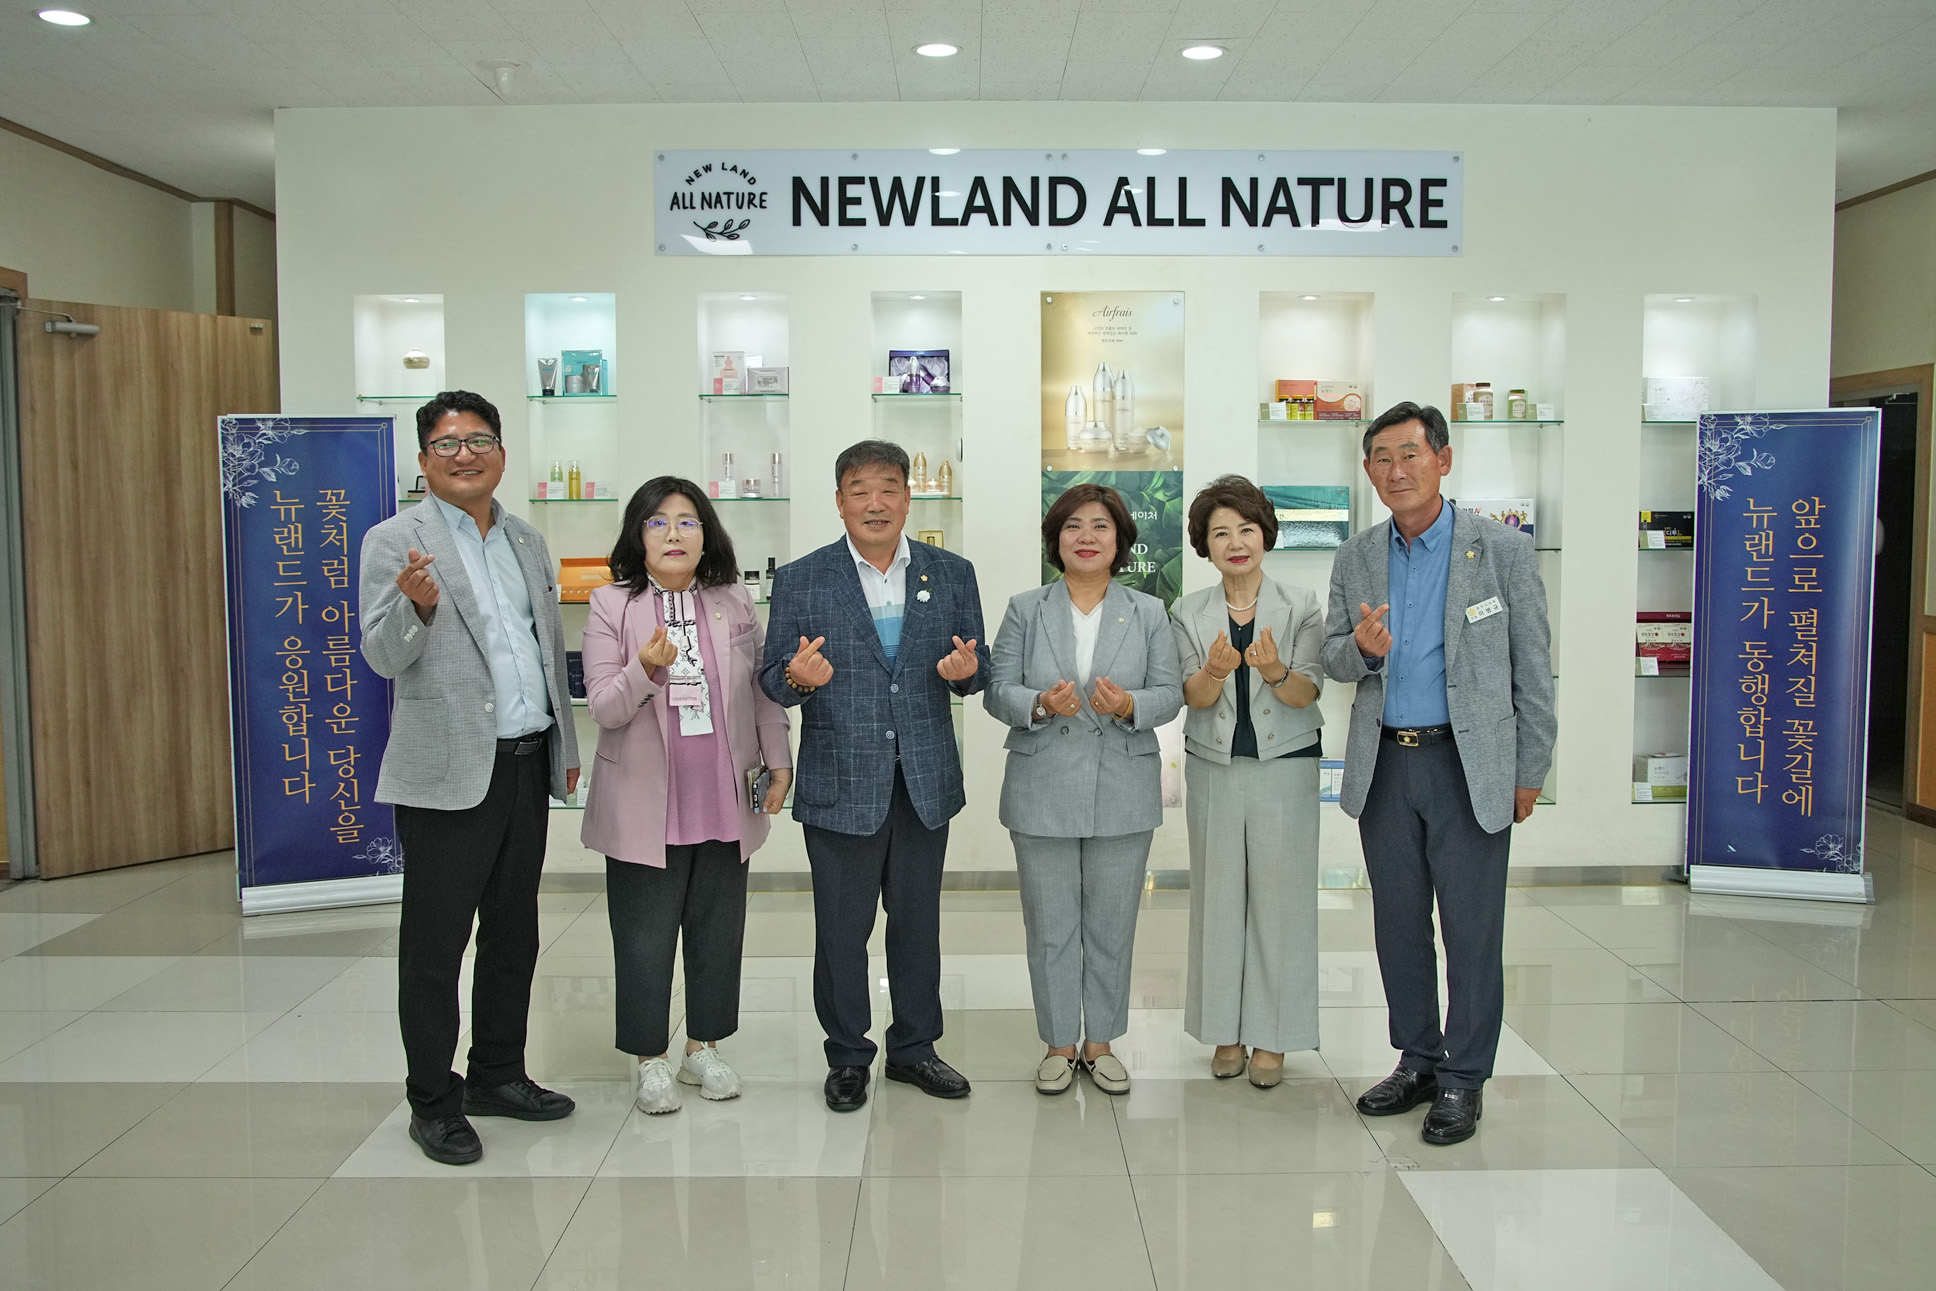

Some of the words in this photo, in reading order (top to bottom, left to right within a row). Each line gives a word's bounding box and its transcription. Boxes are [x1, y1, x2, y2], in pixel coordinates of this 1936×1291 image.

[669, 191, 697, 212] ALL
[700, 191, 769, 211] NATURE
[685, 163, 713, 186] NEW
[721, 162, 757, 186] LAND
[792, 176, 1087, 227] NEWLAND
[1103, 176, 1206, 227] ALL
[1221, 176, 1448, 228] NATURE
[1093, 305, 1132, 321] Airfrais
[270, 490, 309, 625] 뉴랜드가
[316, 489, 351, 589] 꽃처럼
[1741, 497, 1778, 629] 뉴랜드가
[1788, 496, 1827, 593] 앞으로
[322, 600, 359, 734] 아름다운
[1786, 608, 1819, 708] 펼쳐질
[275, 635, 316, 804] 응원합니다
[1735, 641, 1774, 804] 동행합니다
[1782, 719, 1819, 817] 꽃길에
[328, 745, 364, 844] 당신을
